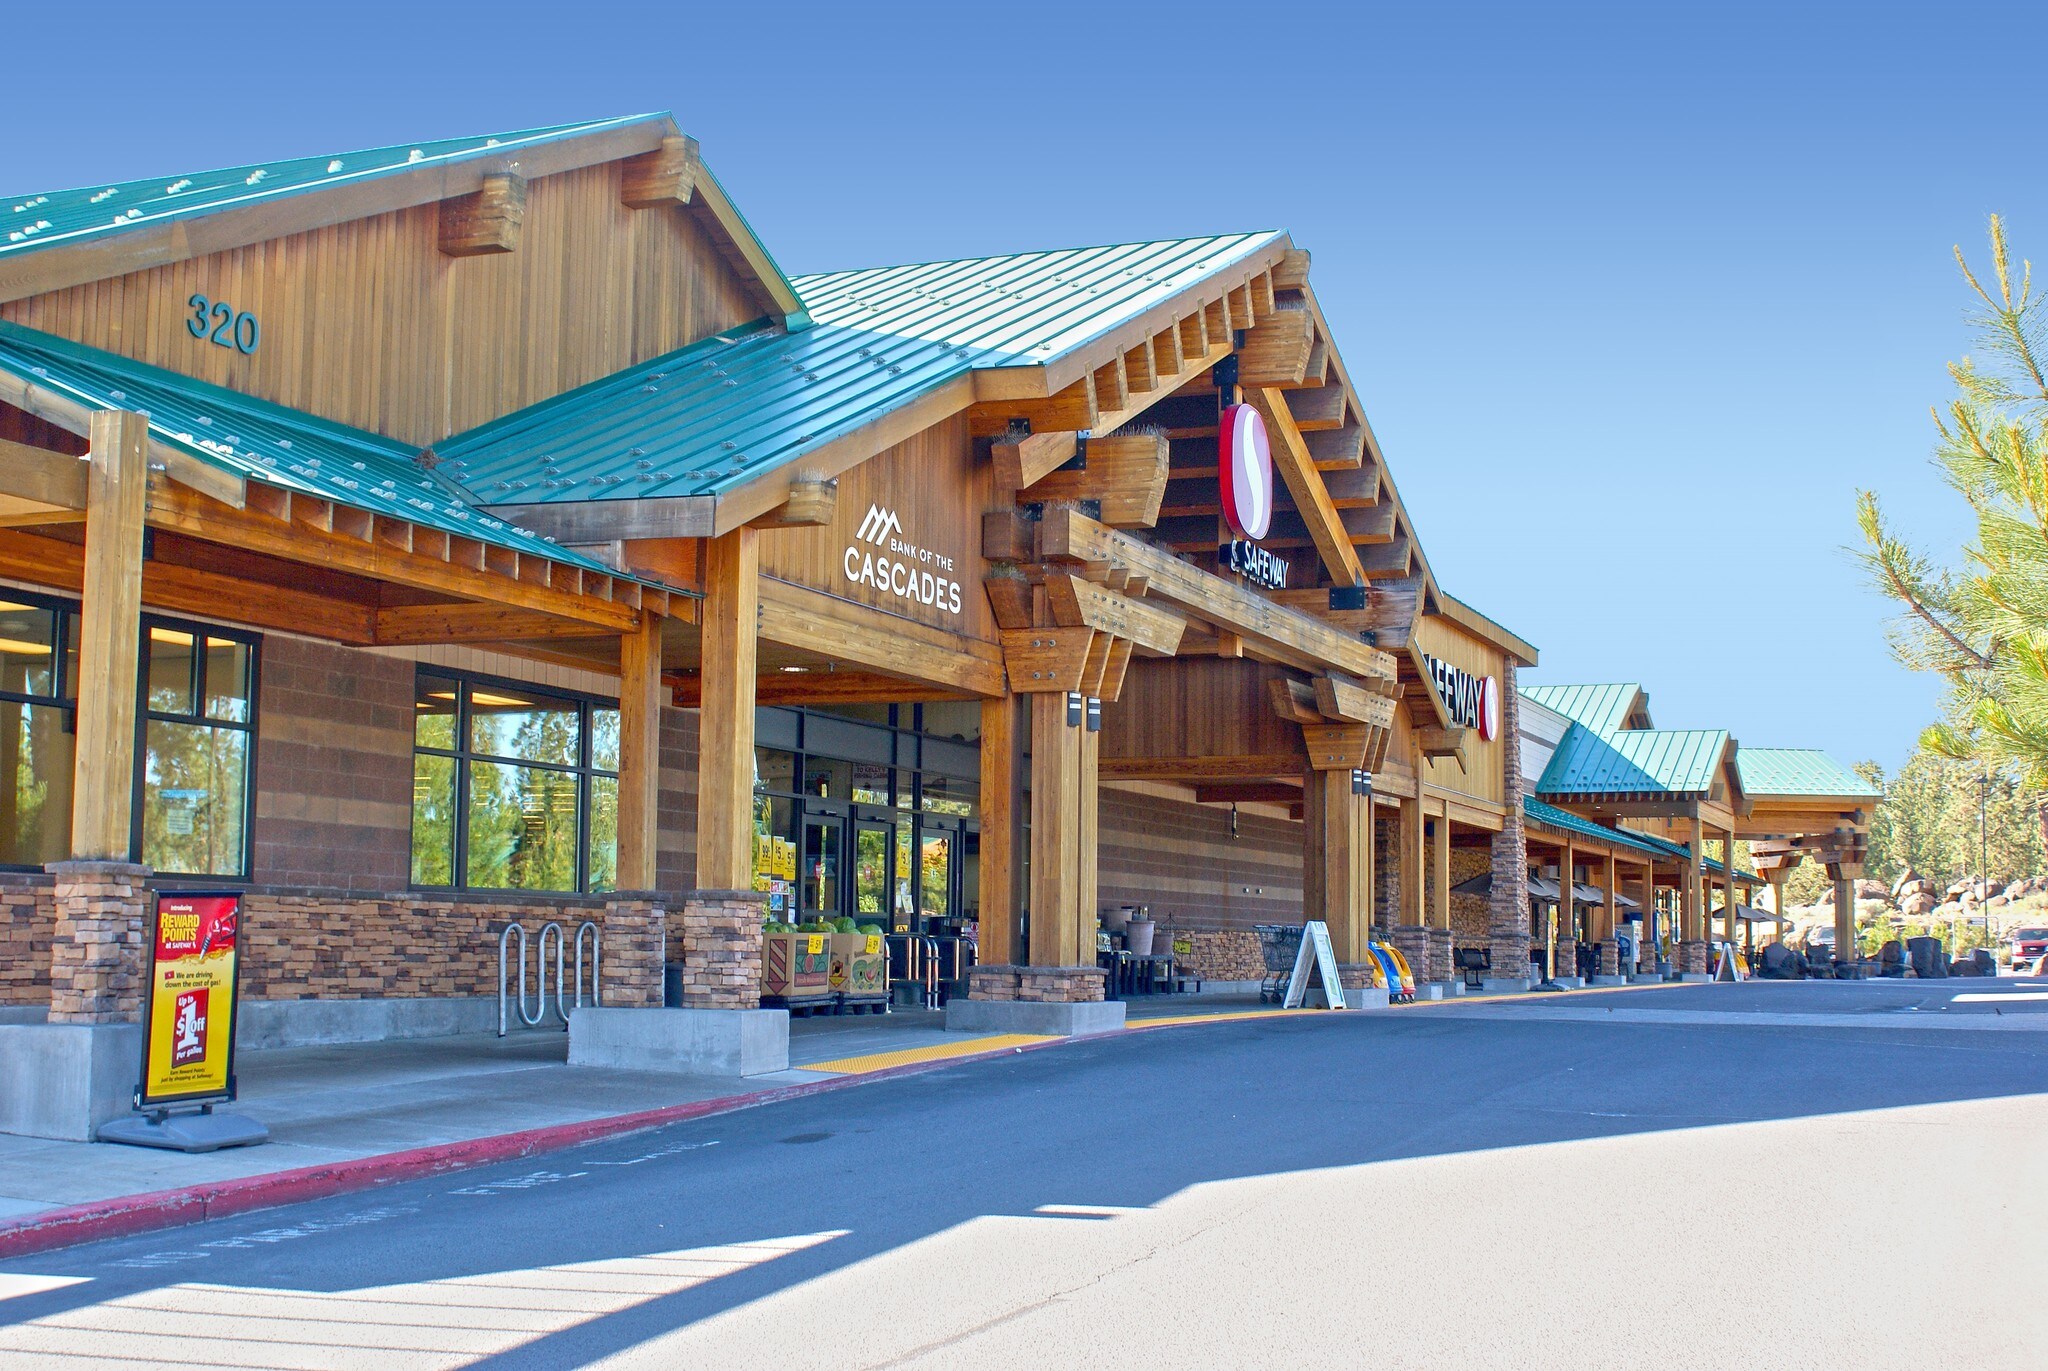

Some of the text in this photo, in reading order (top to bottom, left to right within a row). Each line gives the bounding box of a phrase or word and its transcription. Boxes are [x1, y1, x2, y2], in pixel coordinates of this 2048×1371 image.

[187, 294, 259, 355] 320
[890, 538, 953, 572] BANK OF THE
[1244, 540, 1289, 588] SAFEWAY
[844, 546, 961, 614] CASCADES
[170, 904, 193, 912] Introducing
[160, 912, 200, 928] REWARD
[162, 928, 197, 943] POINTS
[195, 971, 213, 980] driving
[210, 979, 221, 988] gas!
[178, 995, 194, 1007] Up to
[176, 1046, 203, 1060] Per gallon
